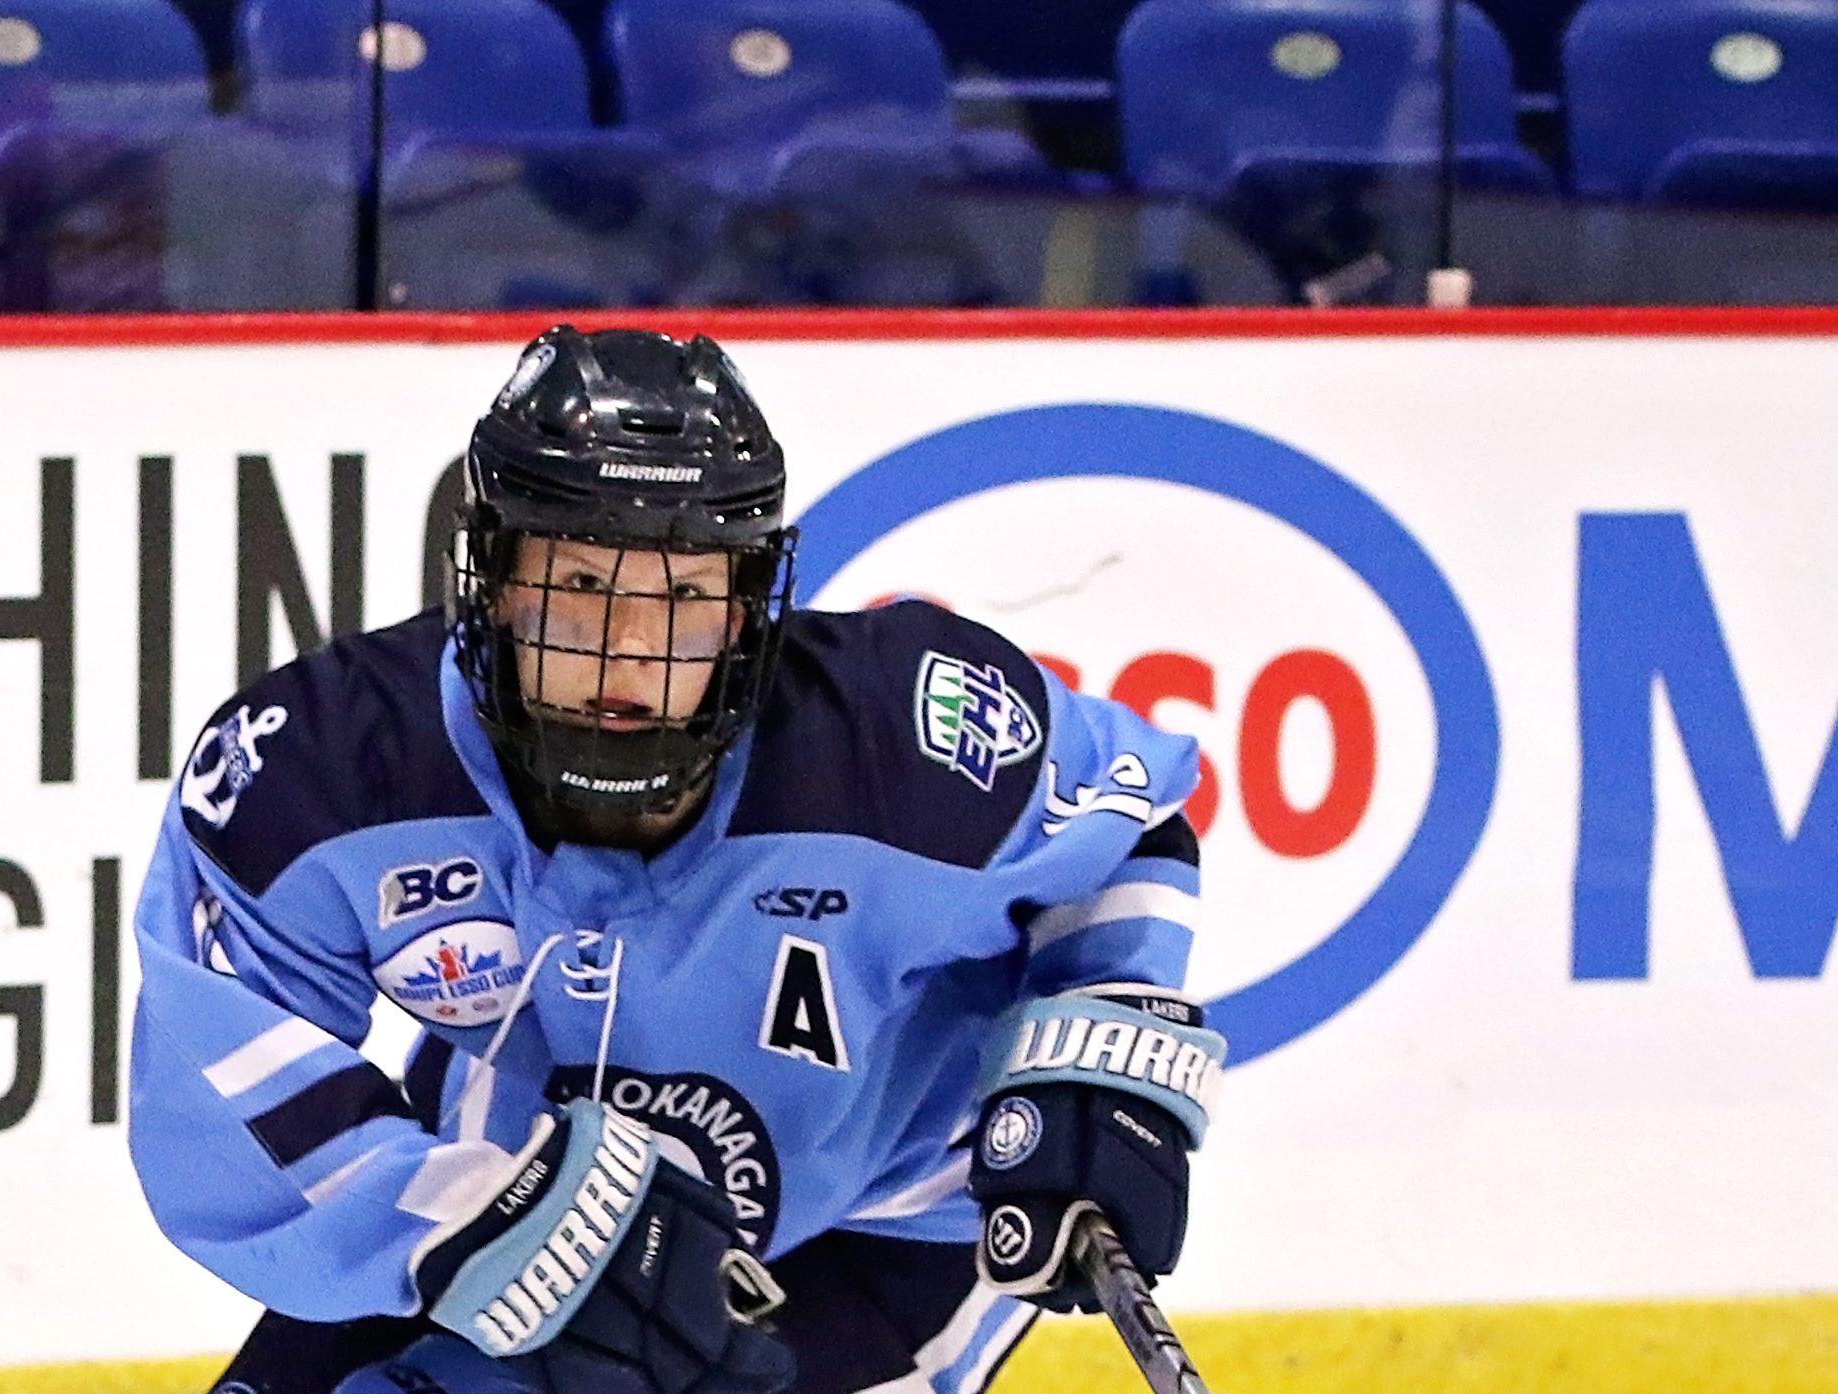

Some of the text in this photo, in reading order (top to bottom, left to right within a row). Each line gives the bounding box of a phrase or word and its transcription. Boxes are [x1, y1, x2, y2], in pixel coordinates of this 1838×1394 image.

[599, 461, 703, 484] WARRIOR
[391, 861, 481, 917] BC
[758, 932, 851, 1074] A
[1007, 1016, 1220, 1100] WARR
